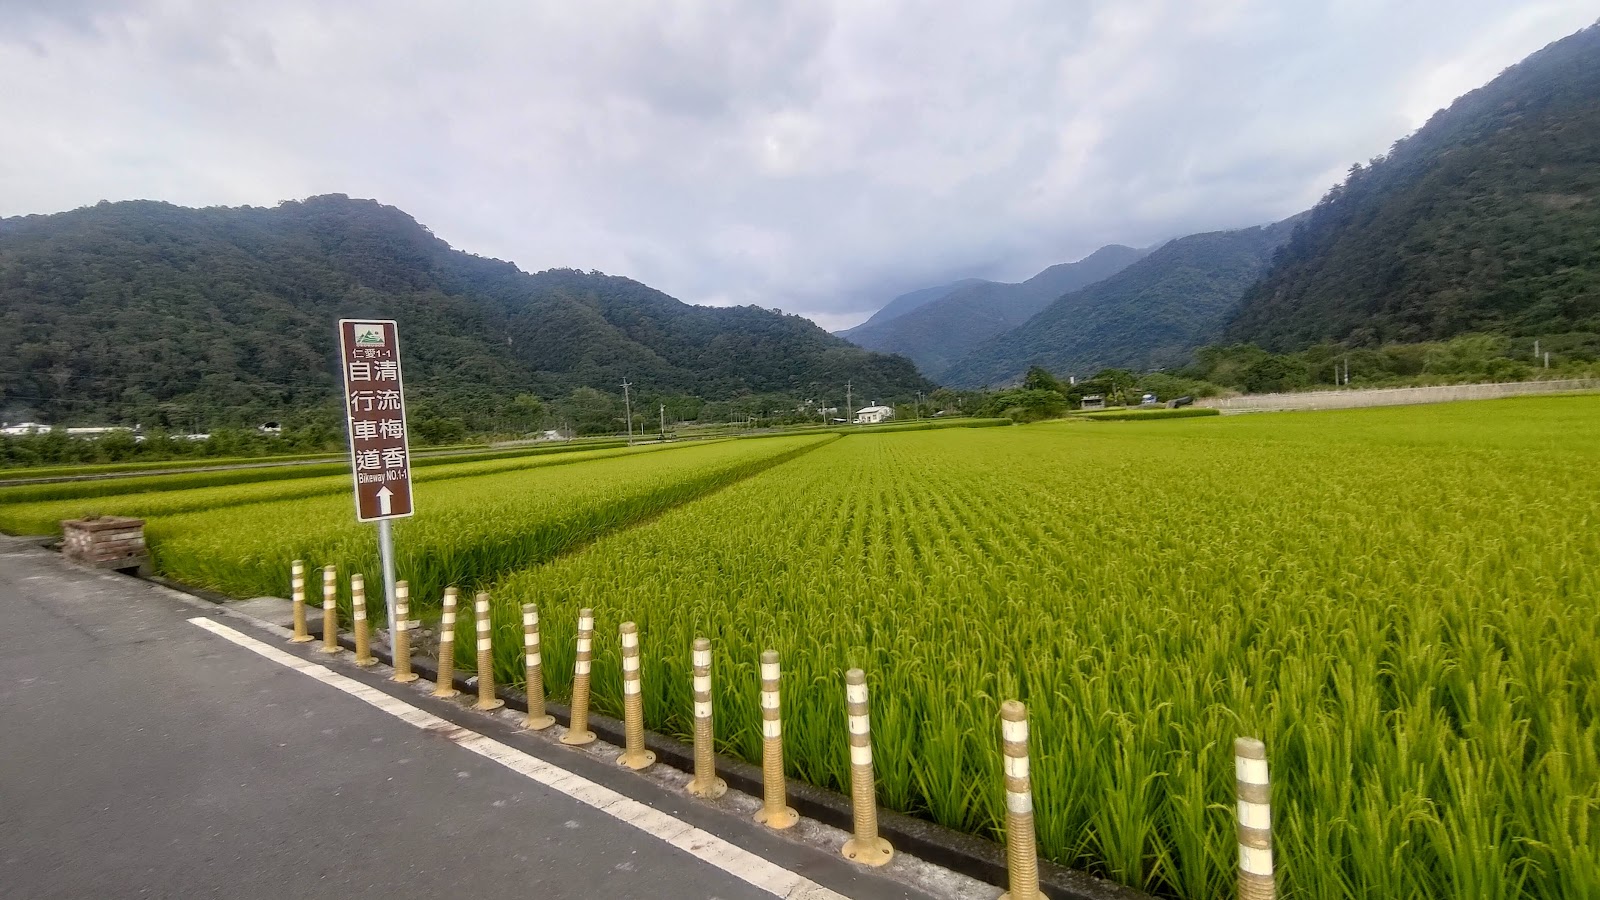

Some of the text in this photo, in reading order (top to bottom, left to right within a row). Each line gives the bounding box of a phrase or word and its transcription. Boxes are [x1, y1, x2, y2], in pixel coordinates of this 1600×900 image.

[349, 360, 382, 471] 自行車道
[374, 360, 405, 469] 清流梅香
[359, 473, 385, 484] Bikeway
